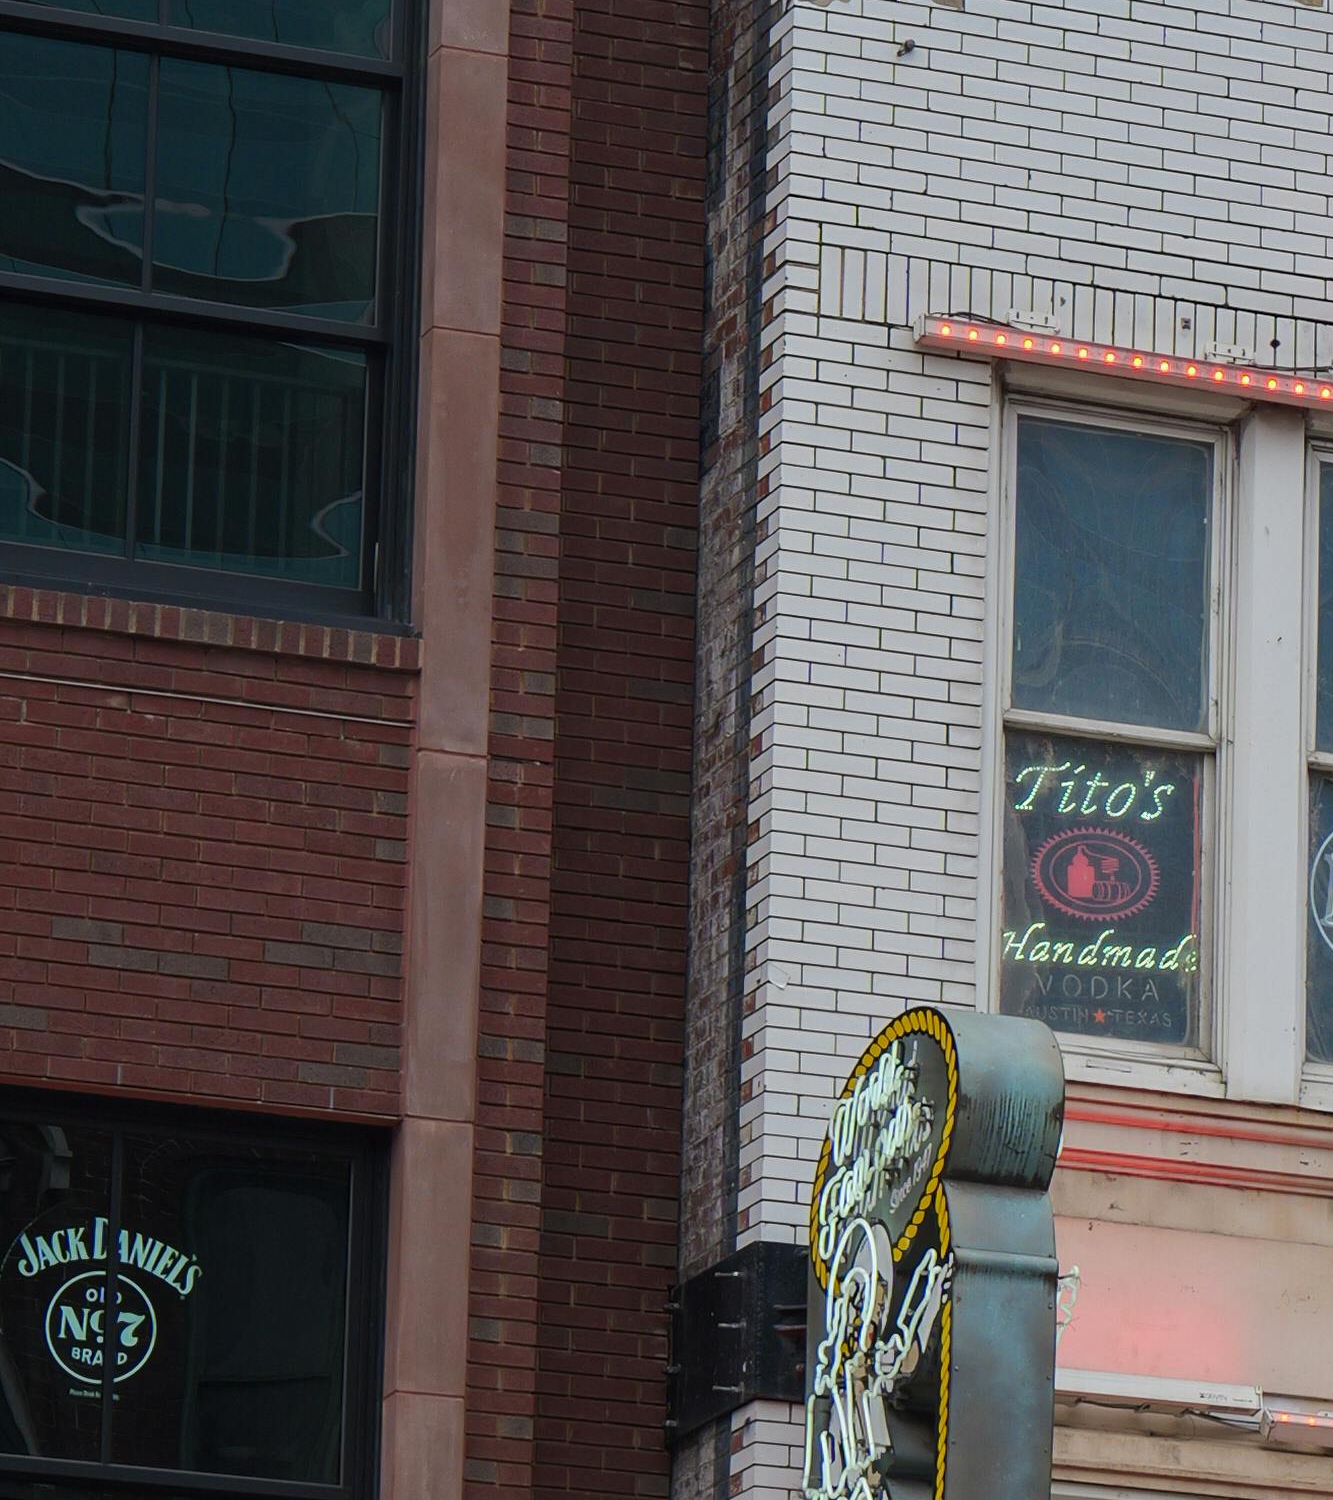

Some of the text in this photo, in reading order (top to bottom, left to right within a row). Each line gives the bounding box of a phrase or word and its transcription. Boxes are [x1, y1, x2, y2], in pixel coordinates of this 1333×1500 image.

[1014, 760, 1175, 822] Tito's
[1034, 972, 1160, 1003] VODKA
[1111, 1010, 1172, 1028] TEXAS
[18, 1226, 90, 1277] JACK
[71, 1347, 128, 1366] BRAD
